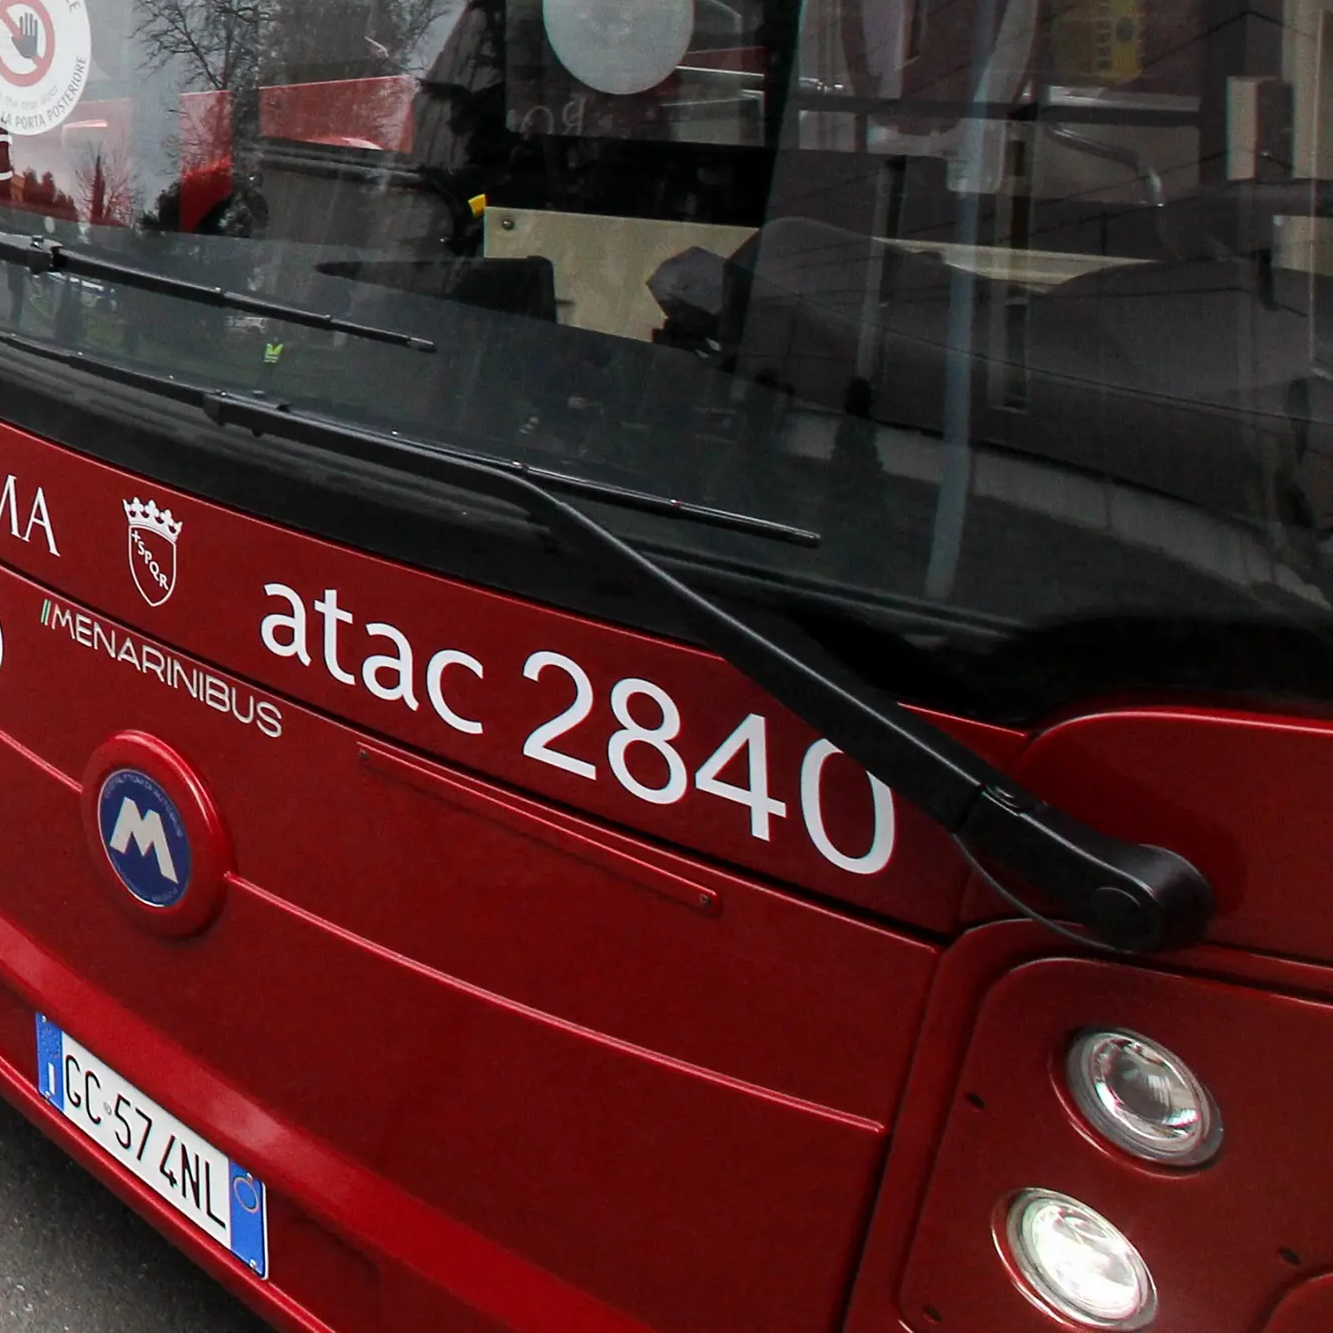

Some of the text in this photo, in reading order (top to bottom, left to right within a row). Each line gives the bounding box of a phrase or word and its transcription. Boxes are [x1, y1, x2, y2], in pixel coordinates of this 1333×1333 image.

[16, 114, 47, 130] PORTA
[47, 56, 86, 123] POSTERIORE
[51, 603, 282, 738] MENARINIBUS
[260, 583, 896, 875] atac 2840
[109, 796, 179, 885] M
